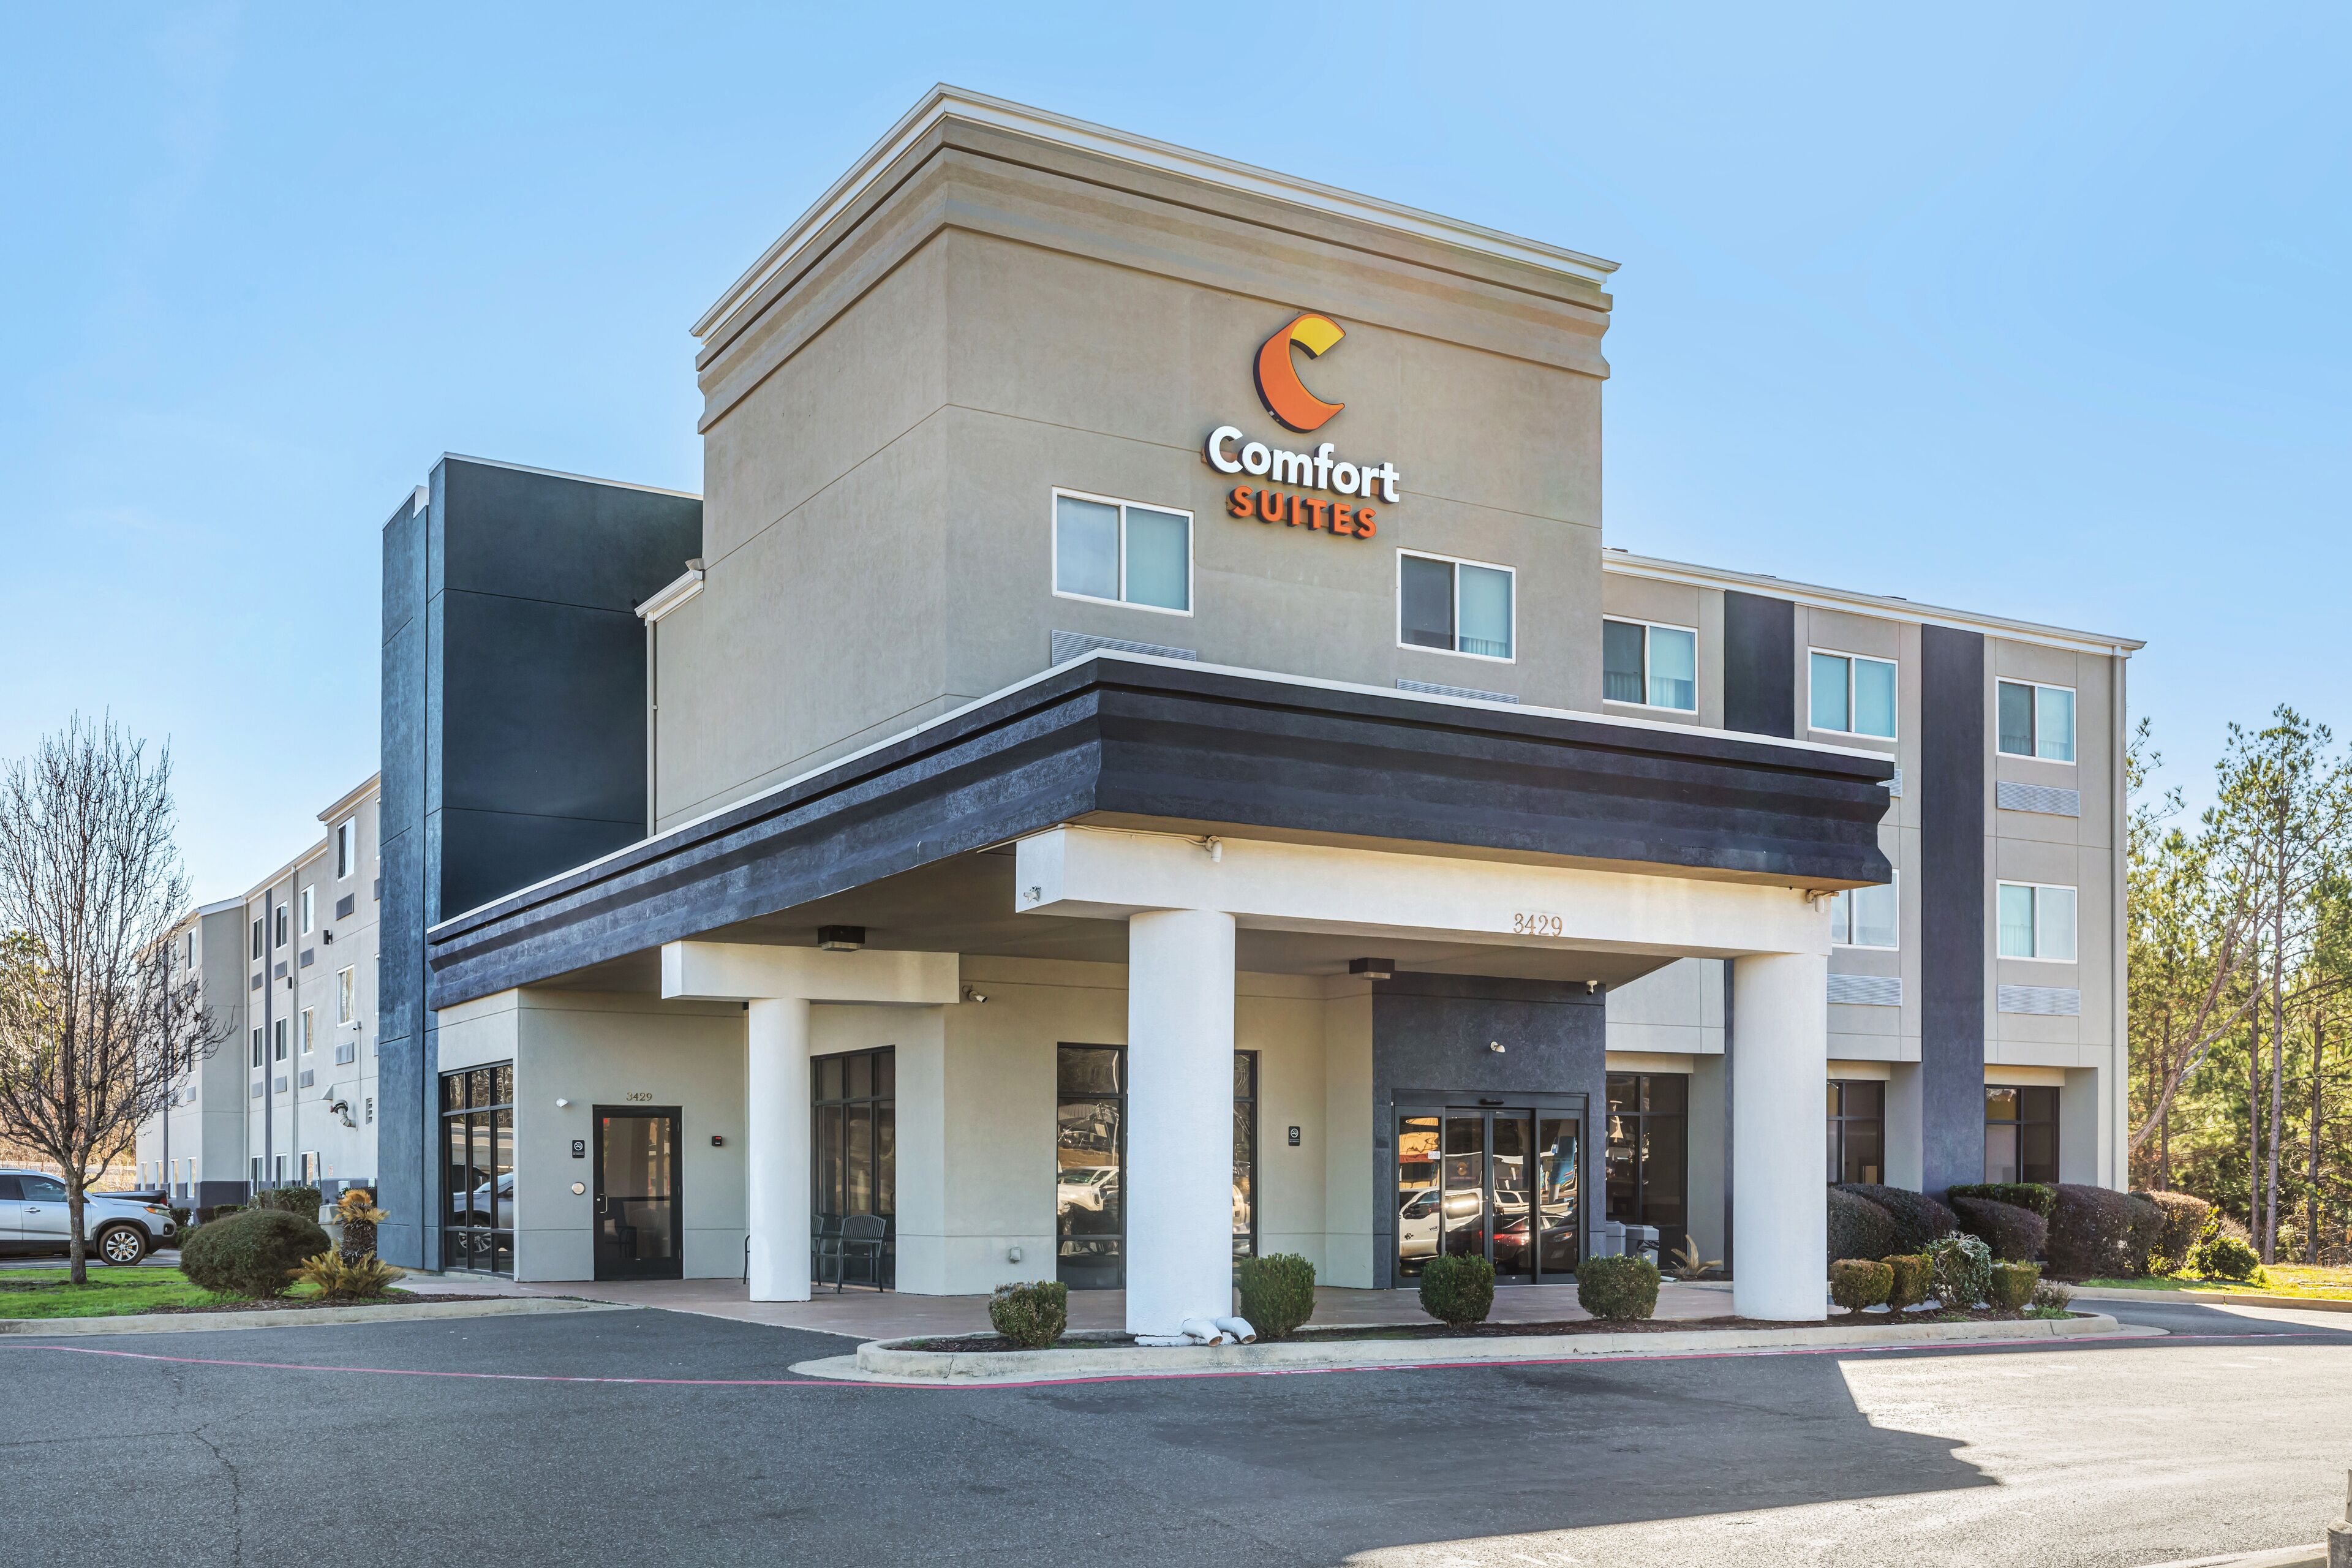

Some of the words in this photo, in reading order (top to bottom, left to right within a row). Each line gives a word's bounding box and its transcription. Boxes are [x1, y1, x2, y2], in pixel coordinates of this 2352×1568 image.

[1205, 426, 1400, 503] Comfort
[1229, 485, 1376, 539] SUITES
[1513, 913, 1562, 938] 3429
[626, 1092, 652, 1101] 3429
